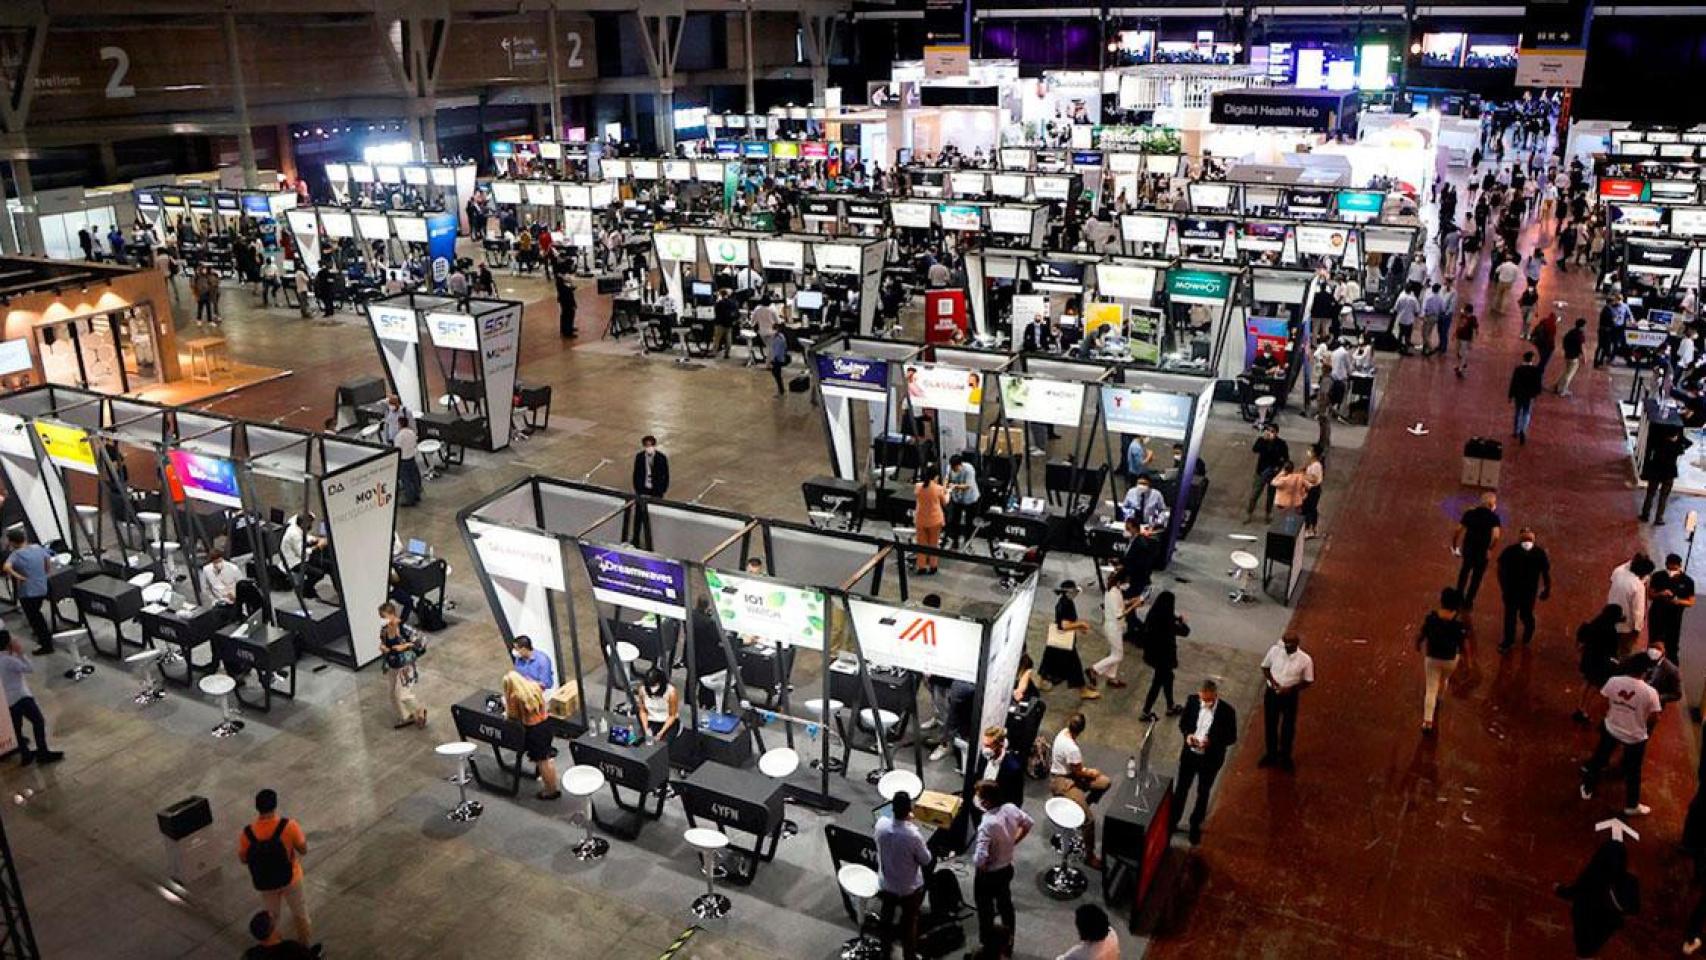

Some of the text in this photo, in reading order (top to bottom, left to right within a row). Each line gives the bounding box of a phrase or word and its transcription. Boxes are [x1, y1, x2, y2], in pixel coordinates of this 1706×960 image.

[568, 32, 584, 68] 2
[100, 47, 136, 98] 2
[1224, 103, 1319, 117] Digital Health Hub
[711, 802, 740, 821] 4YFN
